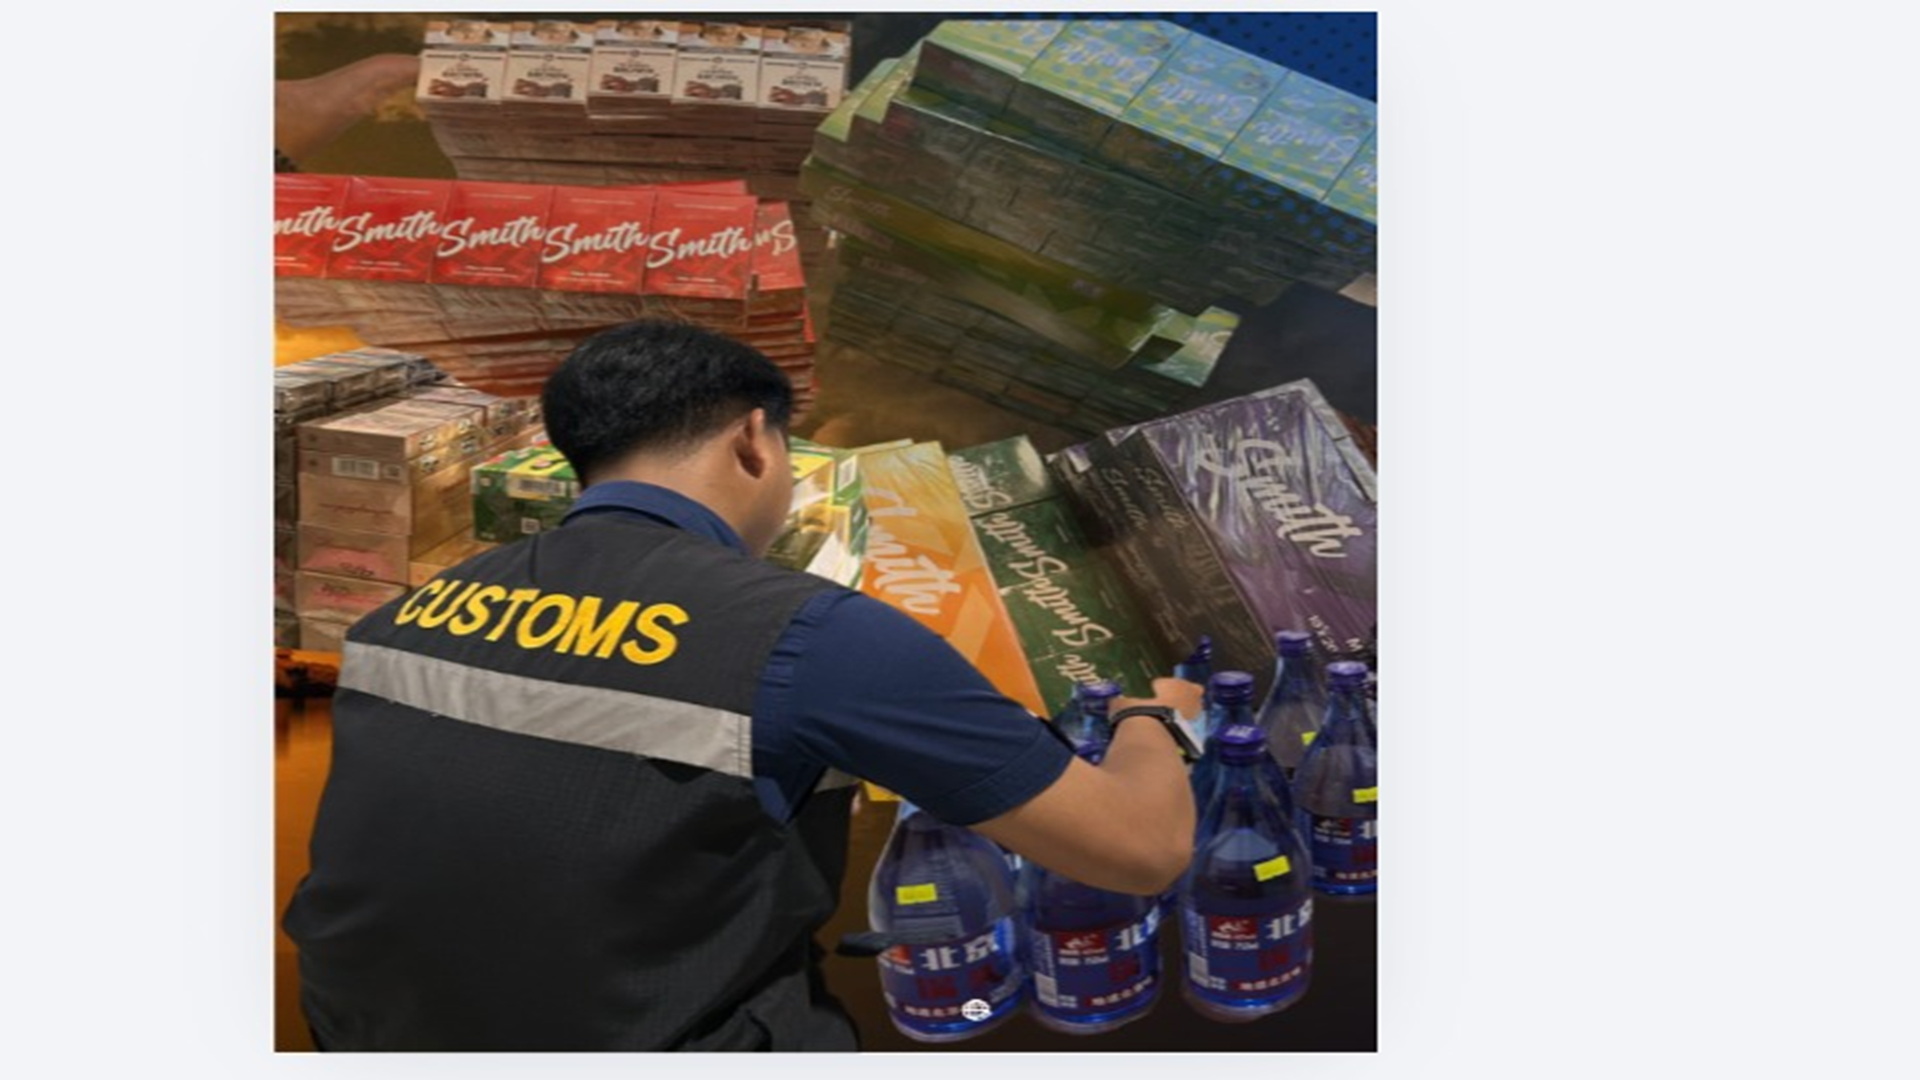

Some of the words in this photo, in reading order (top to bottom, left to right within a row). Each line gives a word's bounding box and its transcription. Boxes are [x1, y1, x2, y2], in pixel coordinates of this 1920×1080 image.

[275, 206, 341, 237] mith
[332, 210, 441, 252] Smith
[436, 216, 546, 257] Smith
[541, 221, 649, 263] Smith
[646, 227, 754, 268] Smith
[1199, 433, 1363, 558] Smith
[978, 512, 1068, 579] Smith
[395, 579, 690, 665] CUSTOMS
[1023, 578, 1113, 647] Smith
[1056, 653, 1108, 686] ith
